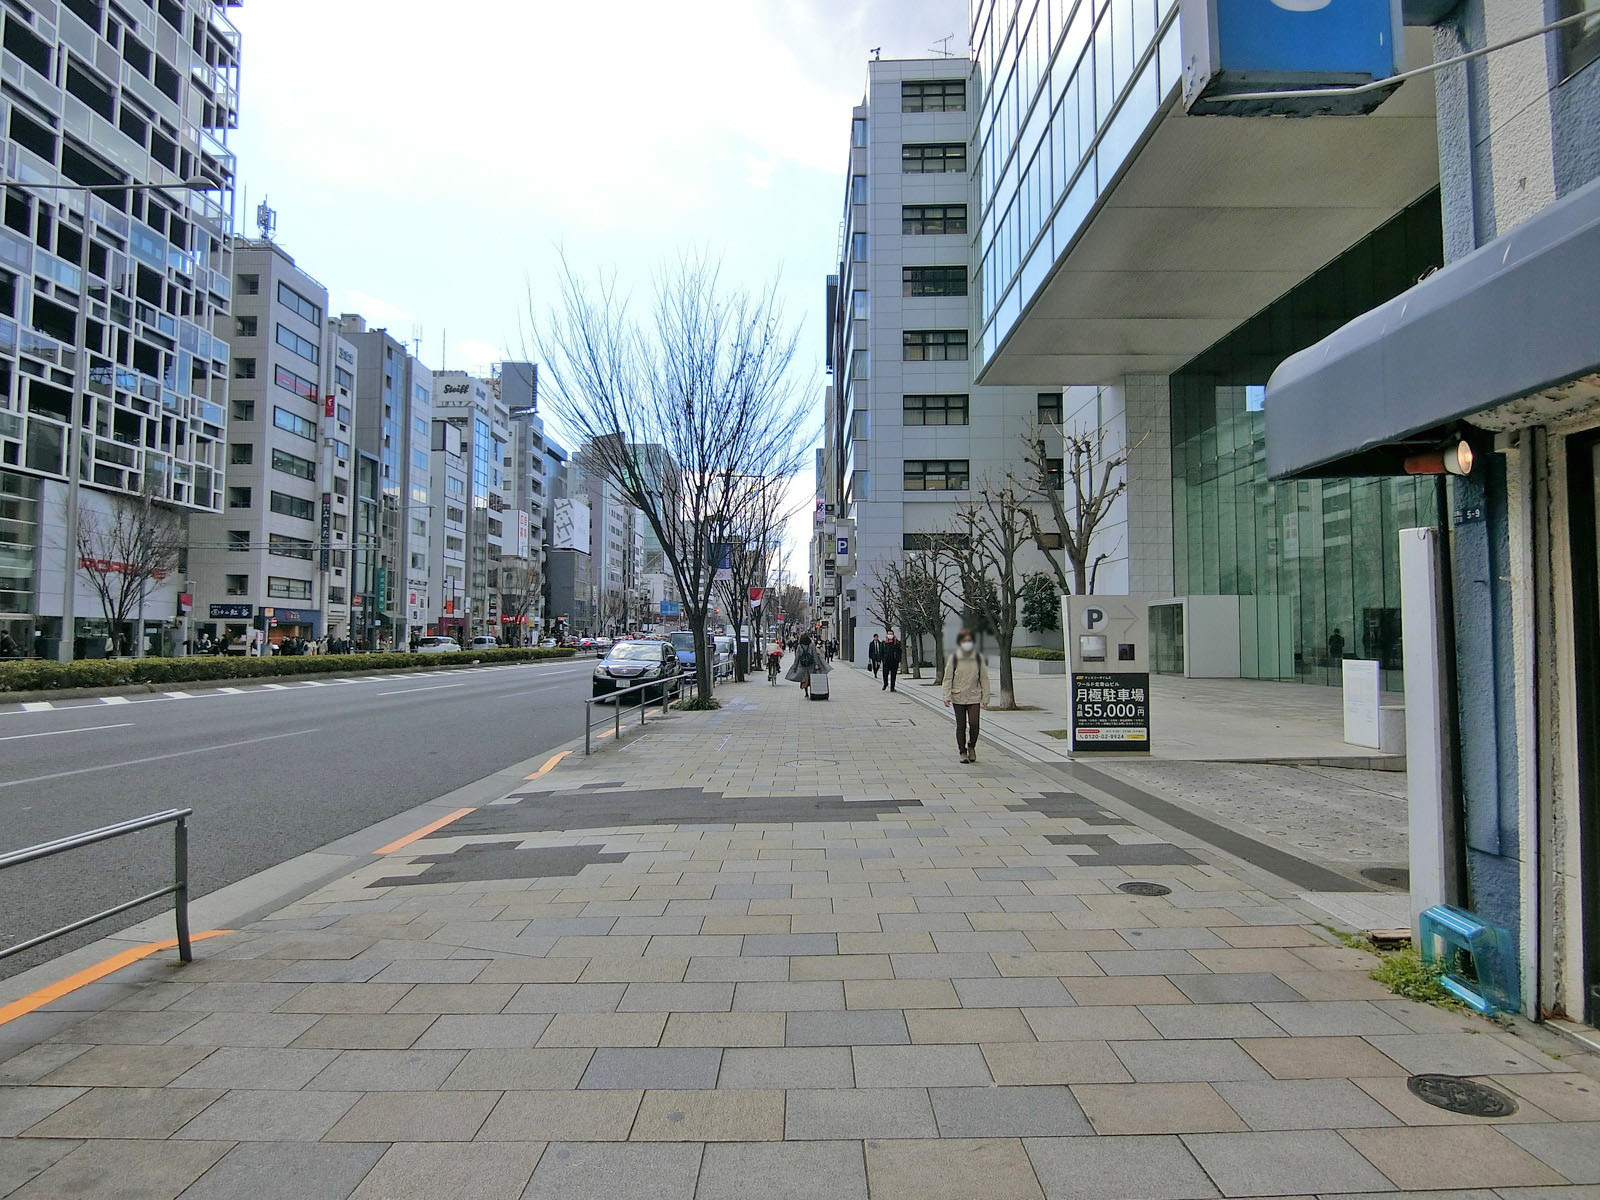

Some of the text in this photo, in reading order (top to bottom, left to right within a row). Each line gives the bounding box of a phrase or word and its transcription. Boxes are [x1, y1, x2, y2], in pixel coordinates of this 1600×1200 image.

[444, 384, 469, 394] Steiff
[1467, 509, 1480, 519] 5-9
[838, 540, 848, 553] P
[1087, 609, 1103, 630] P
[1076, 688, 1145, 702] 月極駐車場
[1084, 703, 1135, 718] 55,000
[1137, 708, 1145, 717] 円
